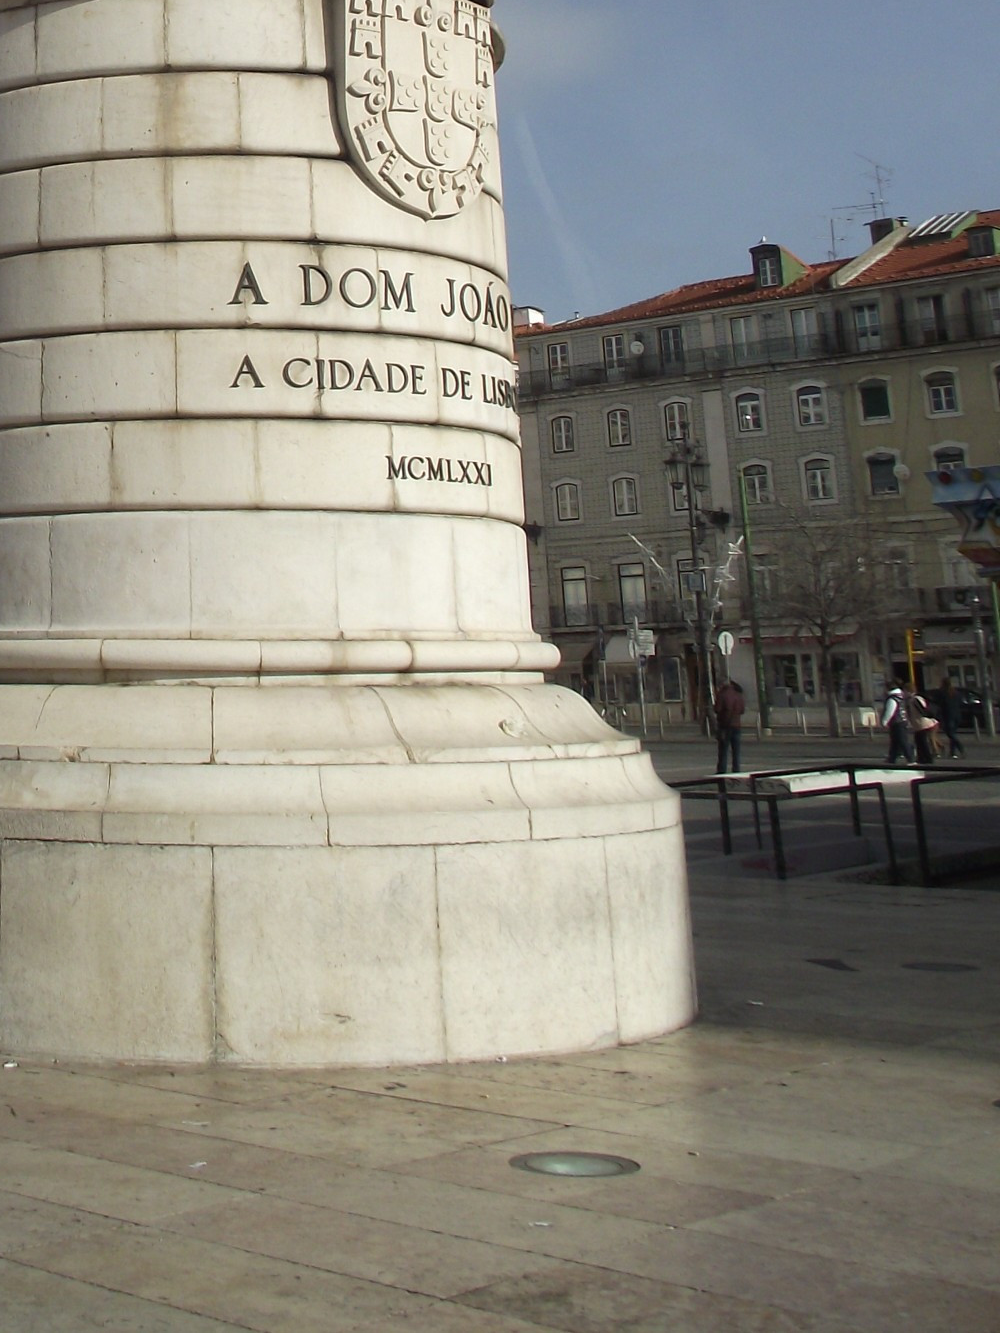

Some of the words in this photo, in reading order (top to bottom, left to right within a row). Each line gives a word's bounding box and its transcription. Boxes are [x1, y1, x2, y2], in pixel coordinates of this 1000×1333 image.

[226, 261, 269, 306] A
[298, 263, 417, 314] DOM
[228, 354, 266, 389] A
[281, 357, 428, 396] CIDADE
[440, 366, 474, 401] DE
[384, 454, 493, 487] MCMLXXI
